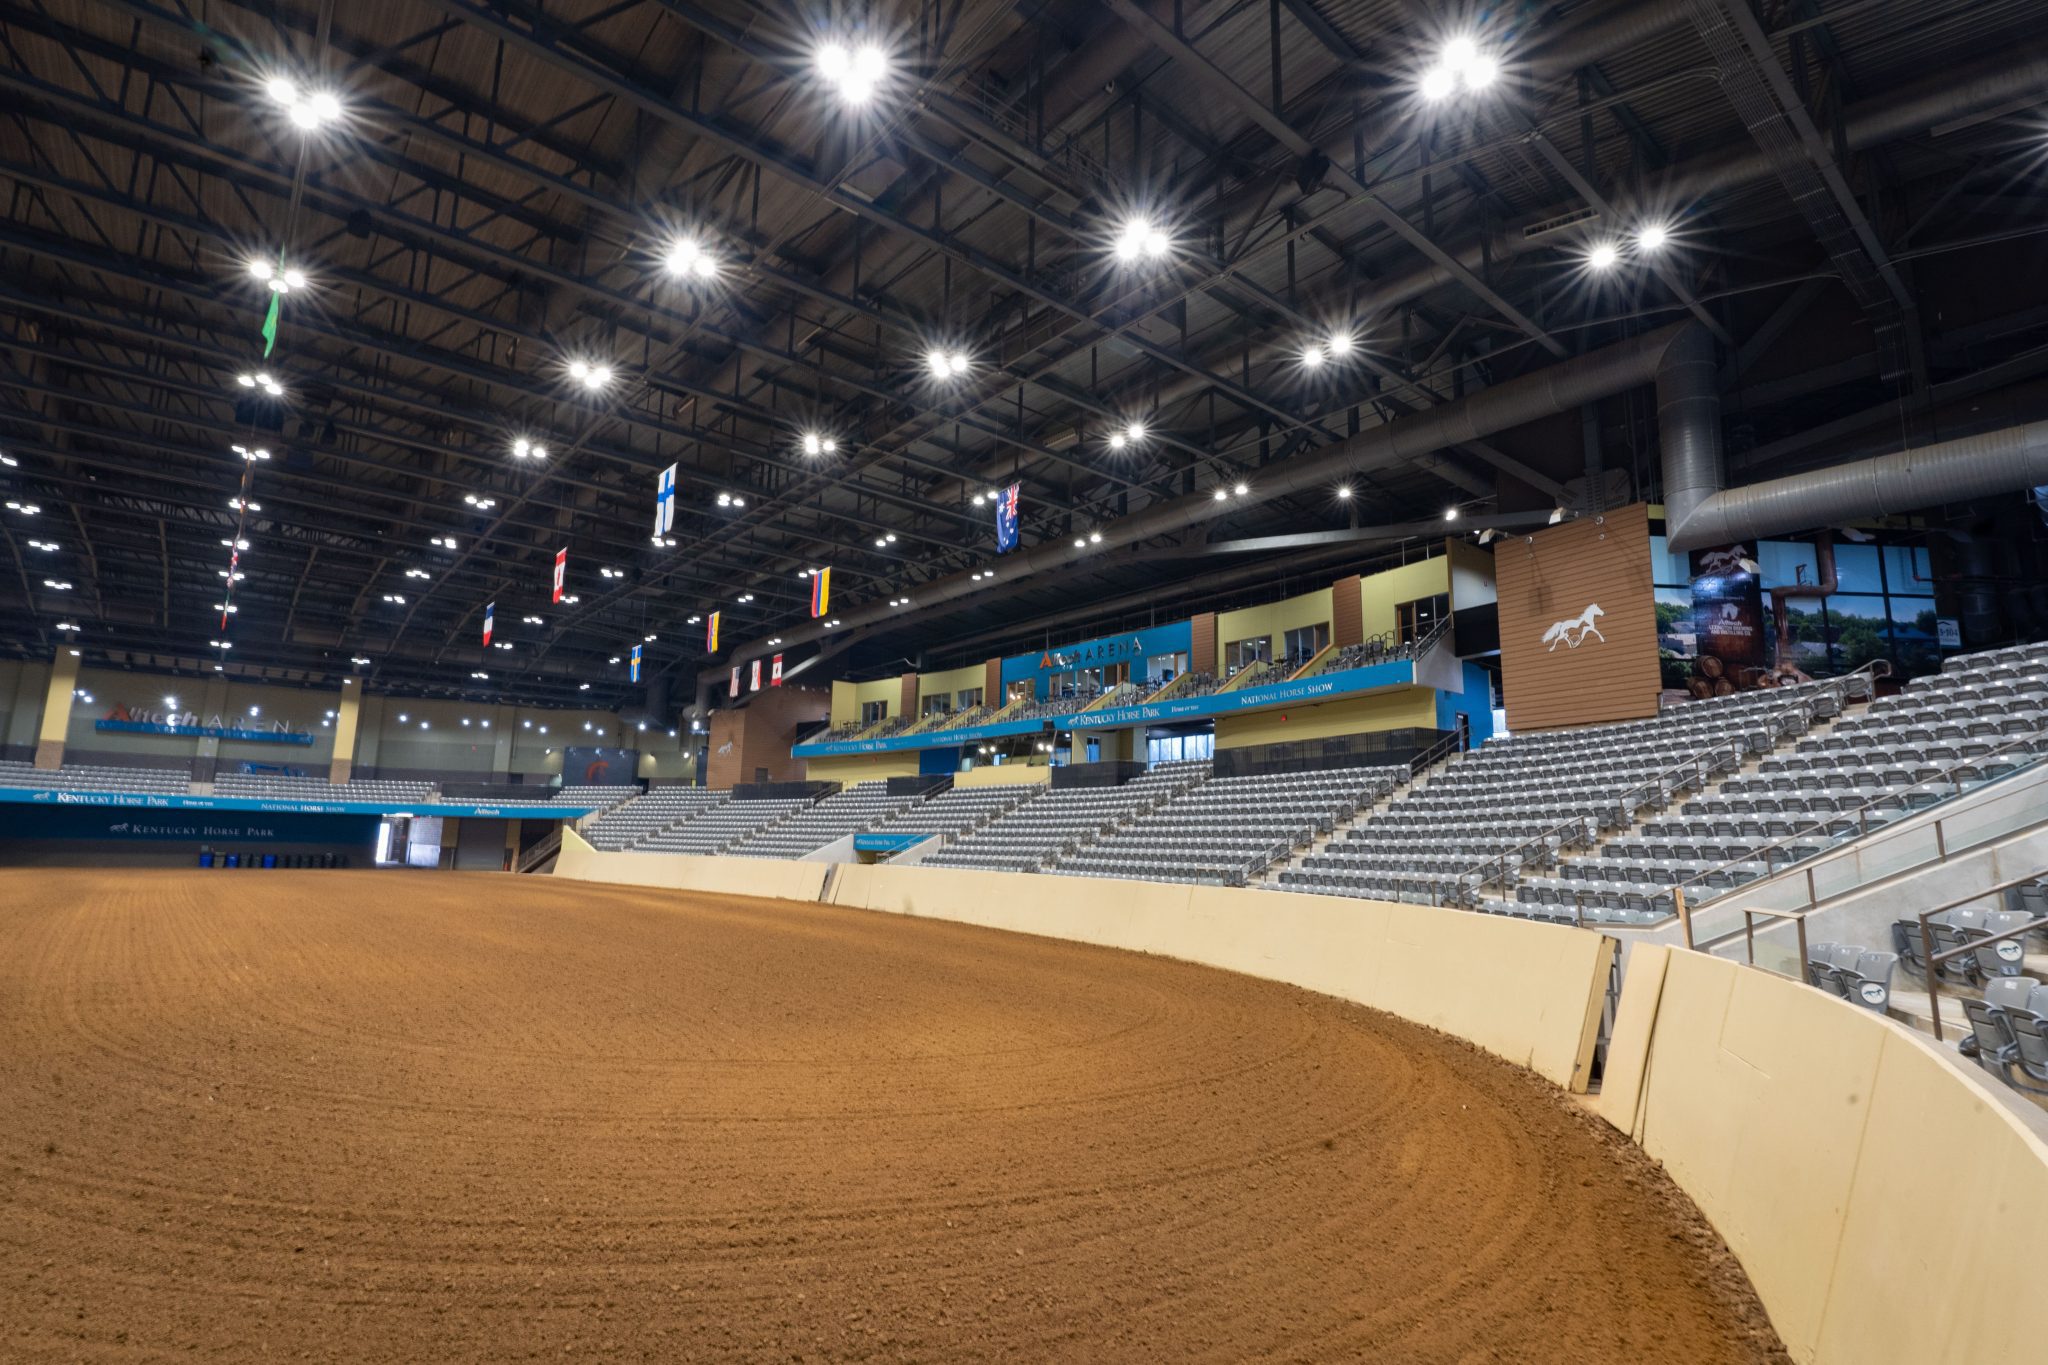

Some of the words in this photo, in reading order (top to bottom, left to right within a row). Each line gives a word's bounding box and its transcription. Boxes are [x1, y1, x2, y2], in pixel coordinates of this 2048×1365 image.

[1085, 636, 1142, 661] ARENA
[1241, 692, 1277, 705] NATIONAL
[1280, 688, 1305, 699] HORSE
[1307, 682, 1333, 694] SHOW
[1080, 713, 1115, 726] KENTUCKY
[1117, 710, 1140, 721] HORSE
[1142, 707, 1160, 718] PARK
[57, 792, 110, 804] KENTUCKY
[113, 795, 144, 805] HORSE
[147, 796, 168, 806] PARK
[261, 803, 298, 811] NATIONAL
[301, 804, 323, 812] HORSE
[132, 824, 197, 835] KENTUCKY
[203, 826, 240, 836] HORSE
[247, 827, 274, 837] PARK
